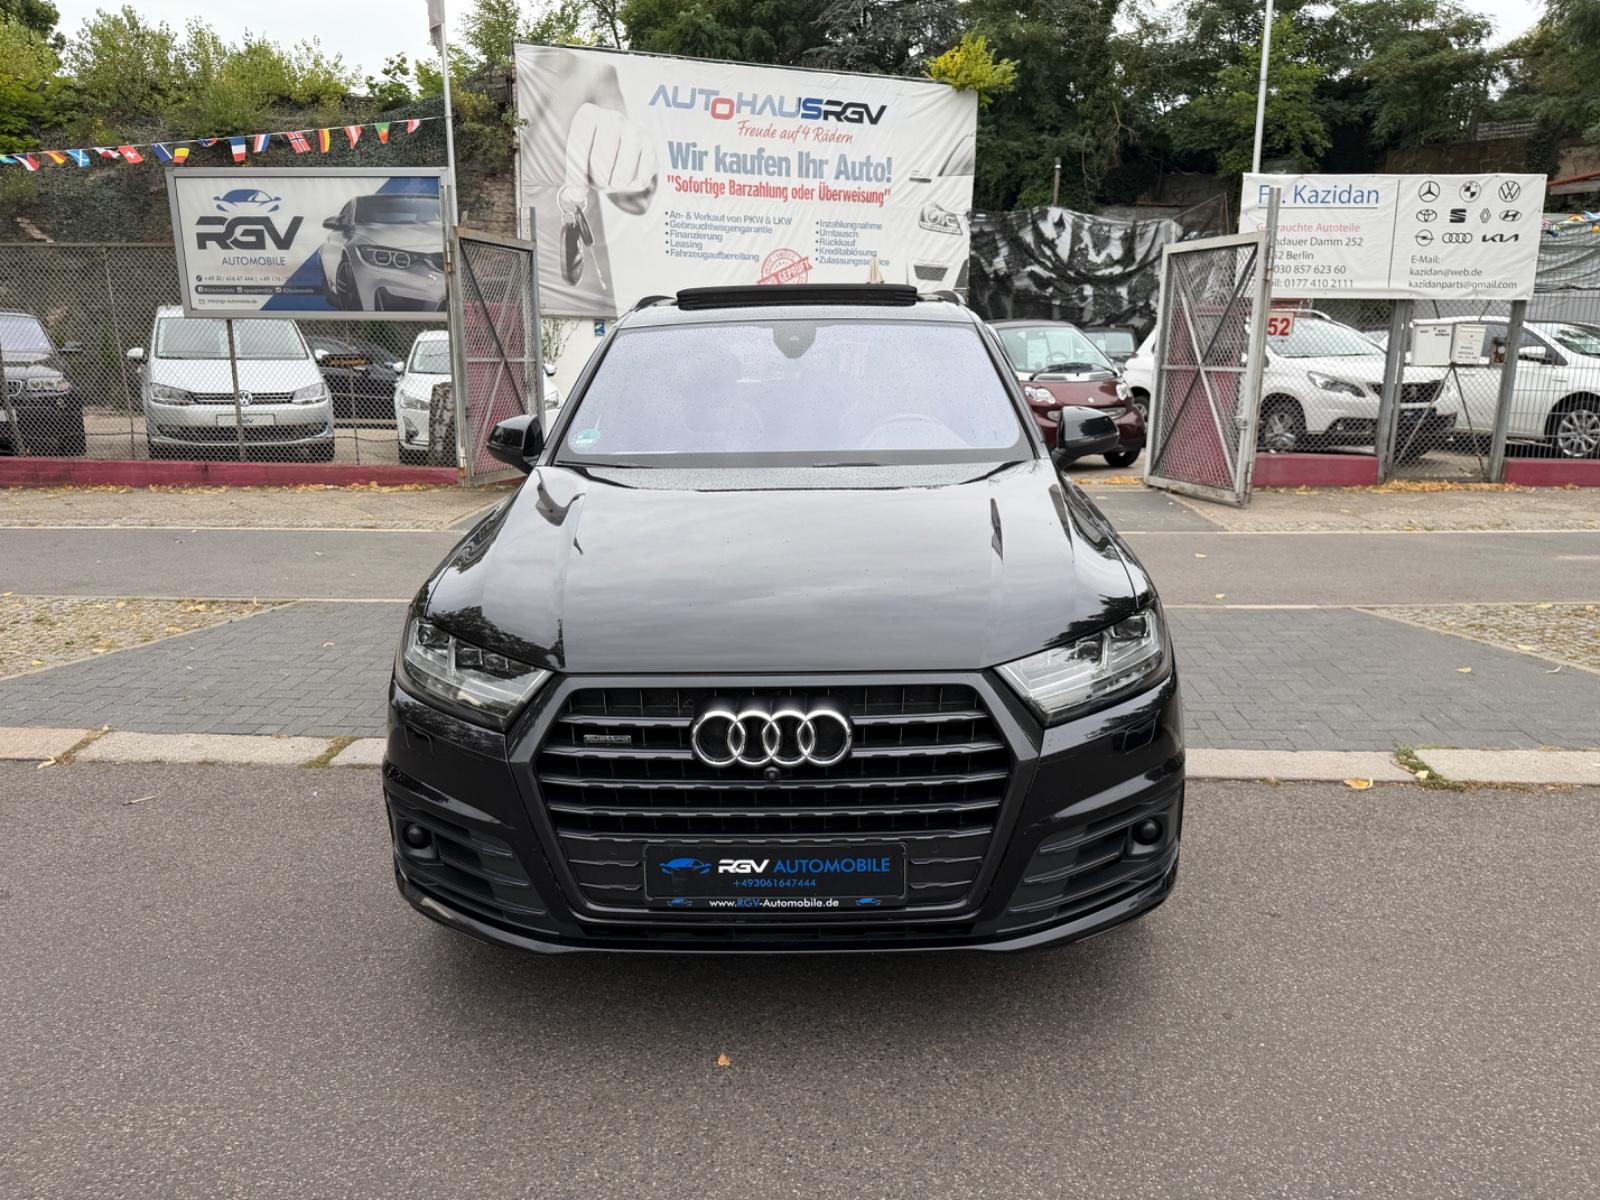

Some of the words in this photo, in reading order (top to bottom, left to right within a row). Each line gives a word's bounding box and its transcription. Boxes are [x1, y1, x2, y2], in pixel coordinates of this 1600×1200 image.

[738, 121, 777, 140] Freude
[780, 125, 803, 143] auf
[803, 126, 811, 140] 4
[814, 127, 854, 144] Rädern
[667, 141, 708, 172] Wir
[714, 145, 790, 178] kaufen
[797, 151, 829, 179] Ihr
[834, 153, 893, 184] Auto!
[667, 175, 726, 199] "Sofortige
[729, 179, 788, 203] Barzahlung
[791, 184, 816, 201] oder
[818, 182, 892, 208] Überweisung"
[1258, 184, 1286, 204] F.
[1293, 183, 1380, 204] Kazidan
[670, 210, 684, 219] An-
[686, 211, 692, 220] &
[693, 212, 725, 222] Verkauf
[726, 215, 742, 223] von
[743, 214, 763, 224] PKW
[773, 216, 792, 225] LKW
[669, 220, 773, 234] Gebrauchtwagengarantie
[819, 219, 883, 230] Inzahlungnahme
[1316, 223, 1360, 233] Autoteile
[195, 216, 304, 250] RGV
[669, 229, 723, 242] Finanzierung
[819, 229, 859, 239] Umtausch
[669, 239, 703, 250] Leasing
[819, 238, 856, 247] Rückkauf
[1310, 236, 1342, 247] Damm
[1345, 236, 1364, 247] 252
[669, 248, 760, 263] Fahrzeugaufbereitung
[819, 247, 877, 258] Kreditablösung
[1286, 250, 1314, 260] Berlin
[222, 256, 286, 266] AUTOMOBILE
[1411, 255, 1440, 264] E-Mail:
[1273, 265, 1291, 274] 030
[1293, 265, 1311, 274] 857
[1313, 265, 1331, 274] 623
[1333, 265, 1347, 274] 60
[1409, 267, 1483, 276] kazidan@web.de
[1284, 279, 1307, 288] 0177
[1311, 279, 1329, 288] 410
[1331, 279, 1354, 288] 2111
[1408, 279, 1517, 290] kazidanparts@gmail.com
[718, 859, 770, 873] RGV
[773, 857, 890, 873] AUTOMOBILE
[733, 878, 817, 888] +493061647444
[709, 898, 839, 909] www.RGV-Automobile.de
